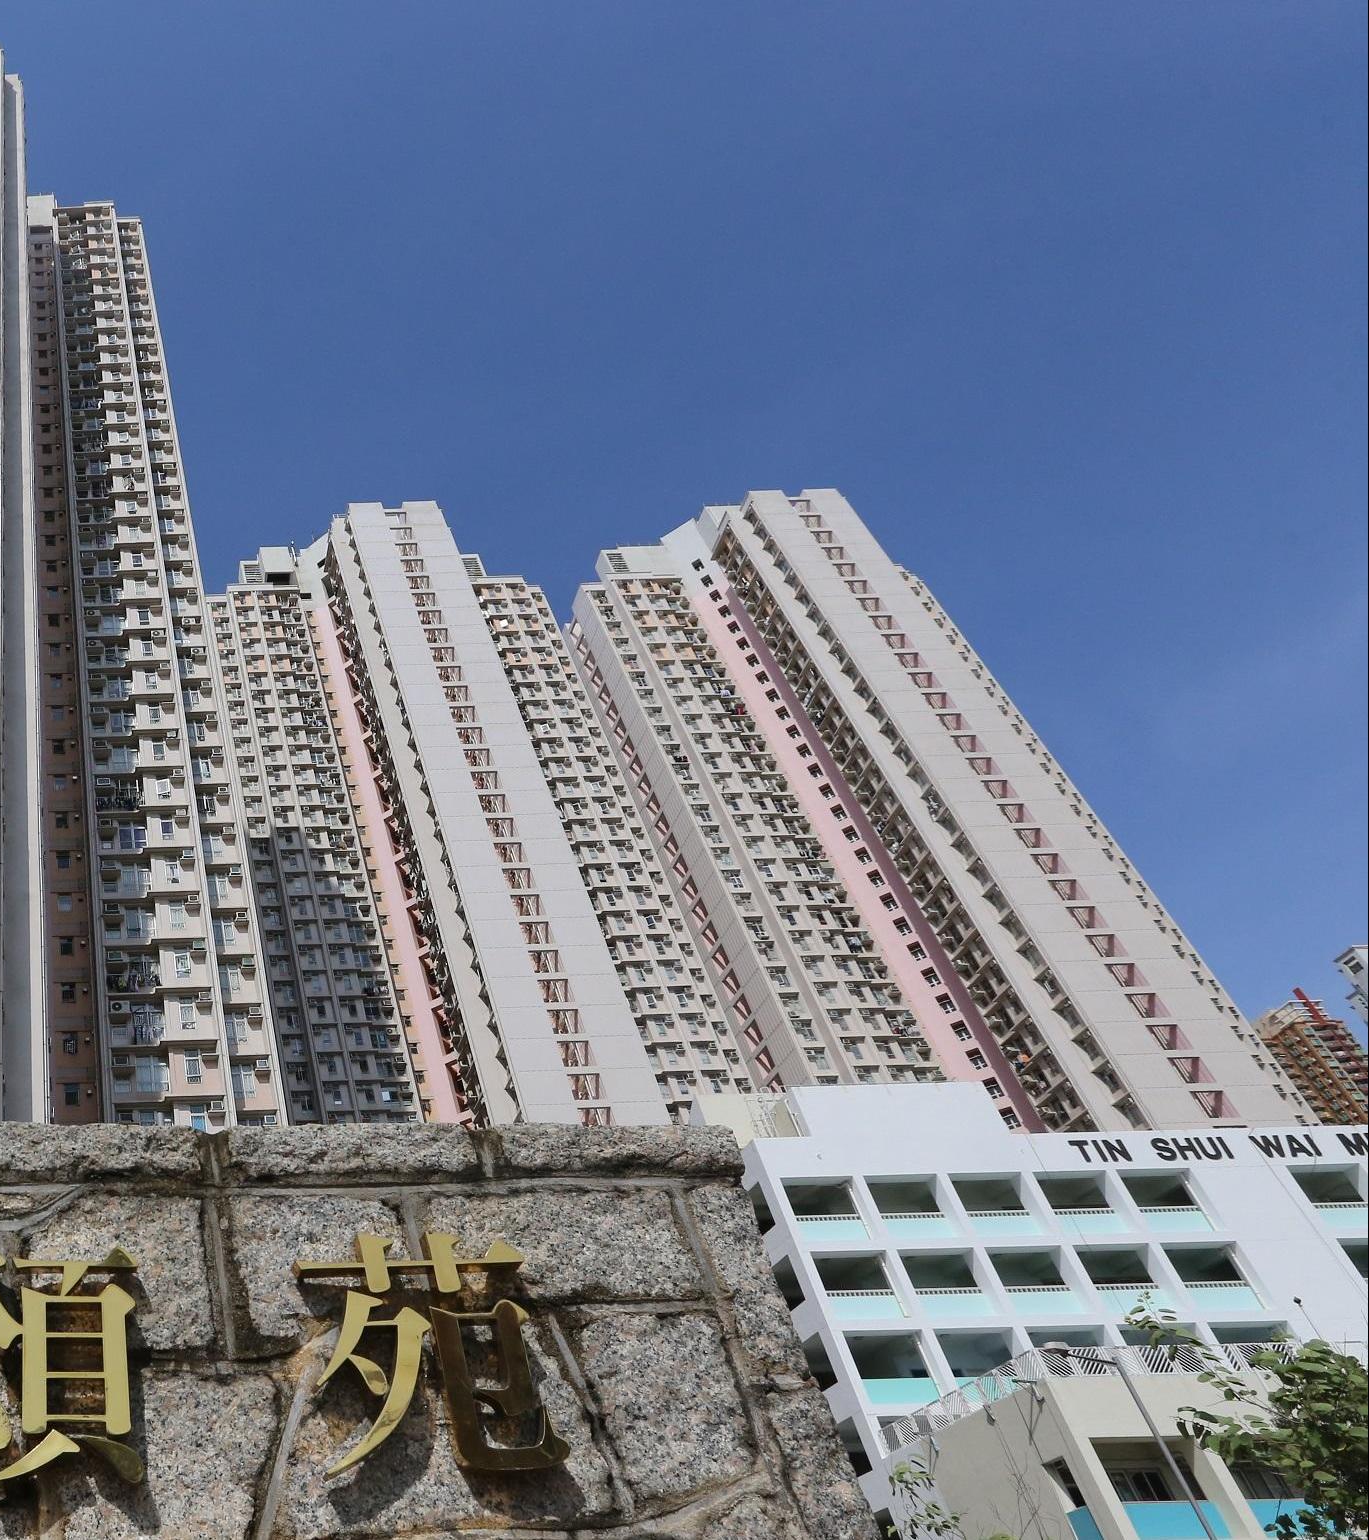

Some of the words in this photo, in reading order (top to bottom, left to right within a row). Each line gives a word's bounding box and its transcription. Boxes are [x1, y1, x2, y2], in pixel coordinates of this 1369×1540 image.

[1068, 1139, 1133, 1163] TIN
[1150, 1136, 1235, 1161] SHUI
[1248, 1133, 1323, 1157] WAI
[1335, 1132, 1368, 1156] M
